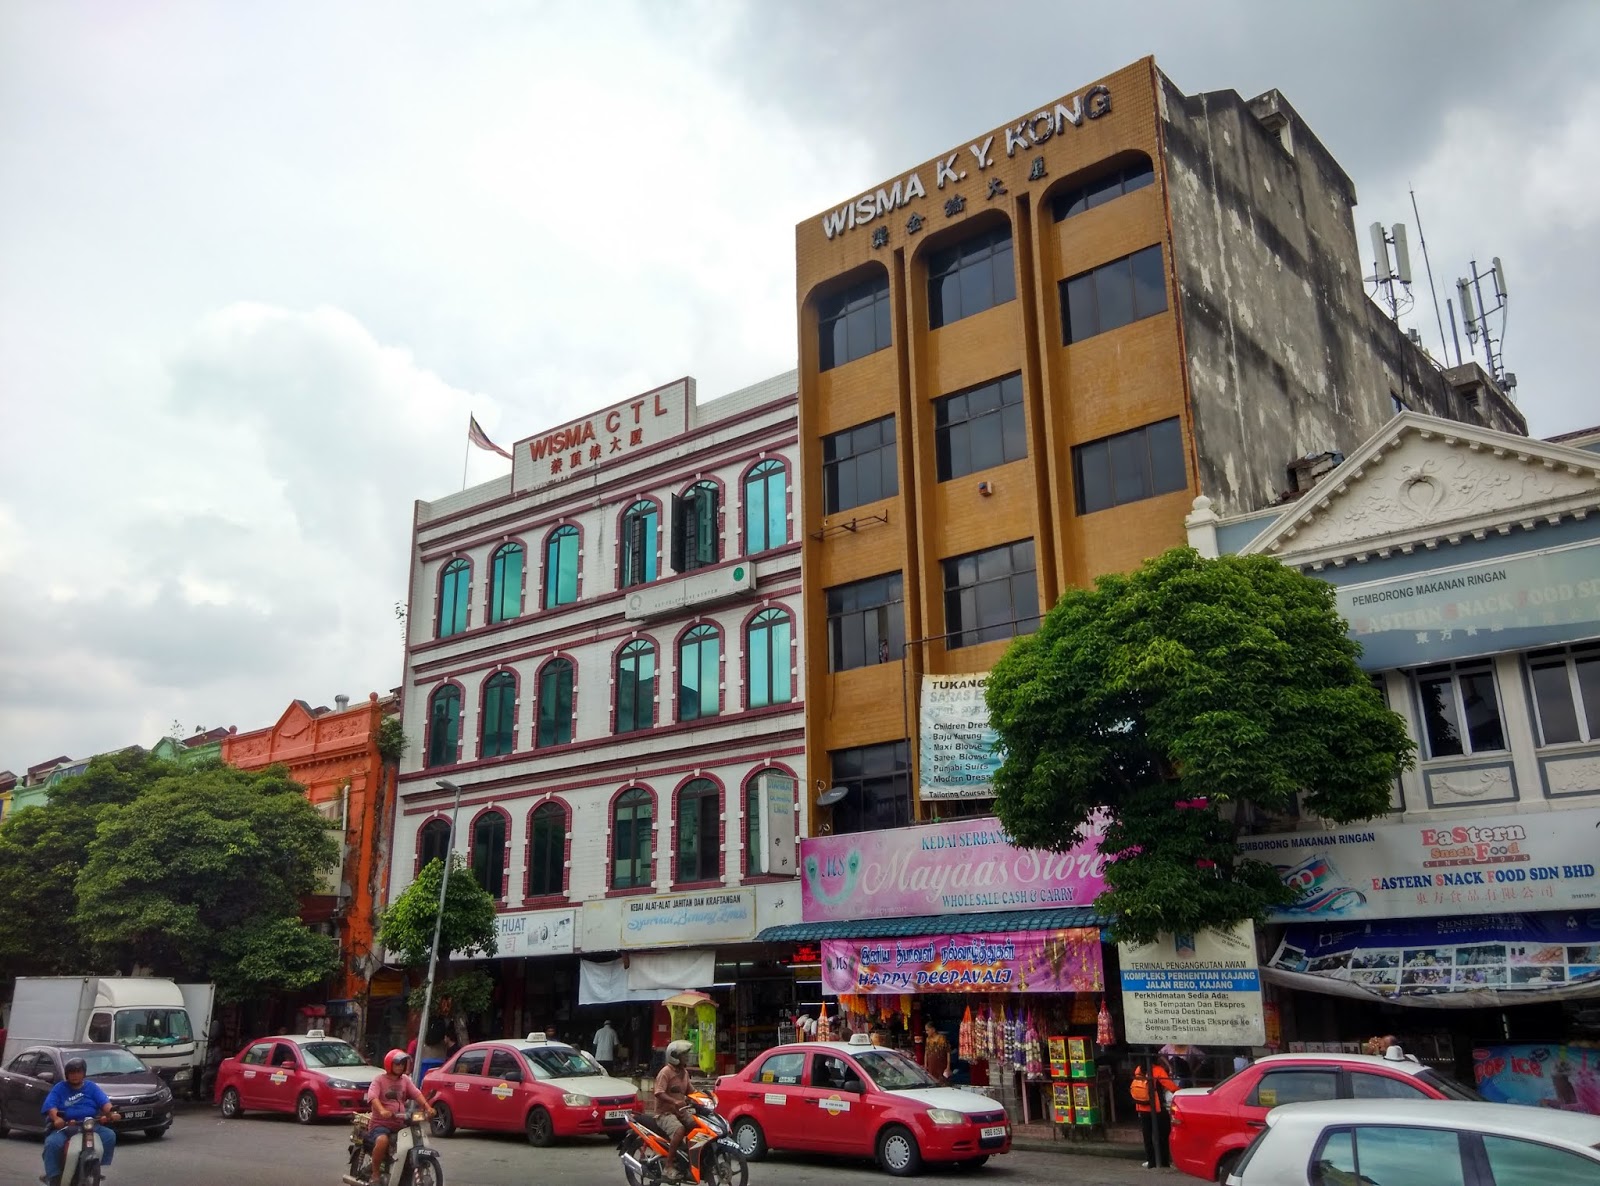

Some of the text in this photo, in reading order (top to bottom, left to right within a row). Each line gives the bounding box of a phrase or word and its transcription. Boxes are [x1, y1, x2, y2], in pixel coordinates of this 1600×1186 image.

[822, 84, 1112, 240] WISMA K. Y. KONG
[529, 420, 596, 462] WISMA
[1352, 569, 1507, 606] PEMBORONG MAKANAN RINGAN
[932, 680, 986, 690] TUKANG
[967, 721, 990, 729] Dres
[921, 834, 957, 850] KEDAI
[1291, 835, 1337, 848] MAKANAN
[1338, 832, 1375, 844] RINGAN
[1431, 846, 1474, 859] Snack
[1372, 863, 1595, 891] EASTERN SNACK FOOD SDN BHD
[942, 887, 1074, 908] WHOLESALE CASH & CARRY
[502, 918, 527, 932] HUAT
[1131, 962, 1165, 970] TERMINAL
[1166, 961, 1223, 969] PENGANGKUTAN
[858, 973, 912, 987] HAPPY
[916, 969, 1012, 984] DEEPAVALI
[1124, 972, 1255, 980] KOMPLEKS PERHENTIAN KAJANG
[1146, 981, 1233, 990] JALAN REKO, KAJANG
[1159, 1001, 1196, 1010] Tempatan
[1214, 1002, 1246, 1010] Ekspres
[1207, 1019, 1238, 1027] Ekspres
